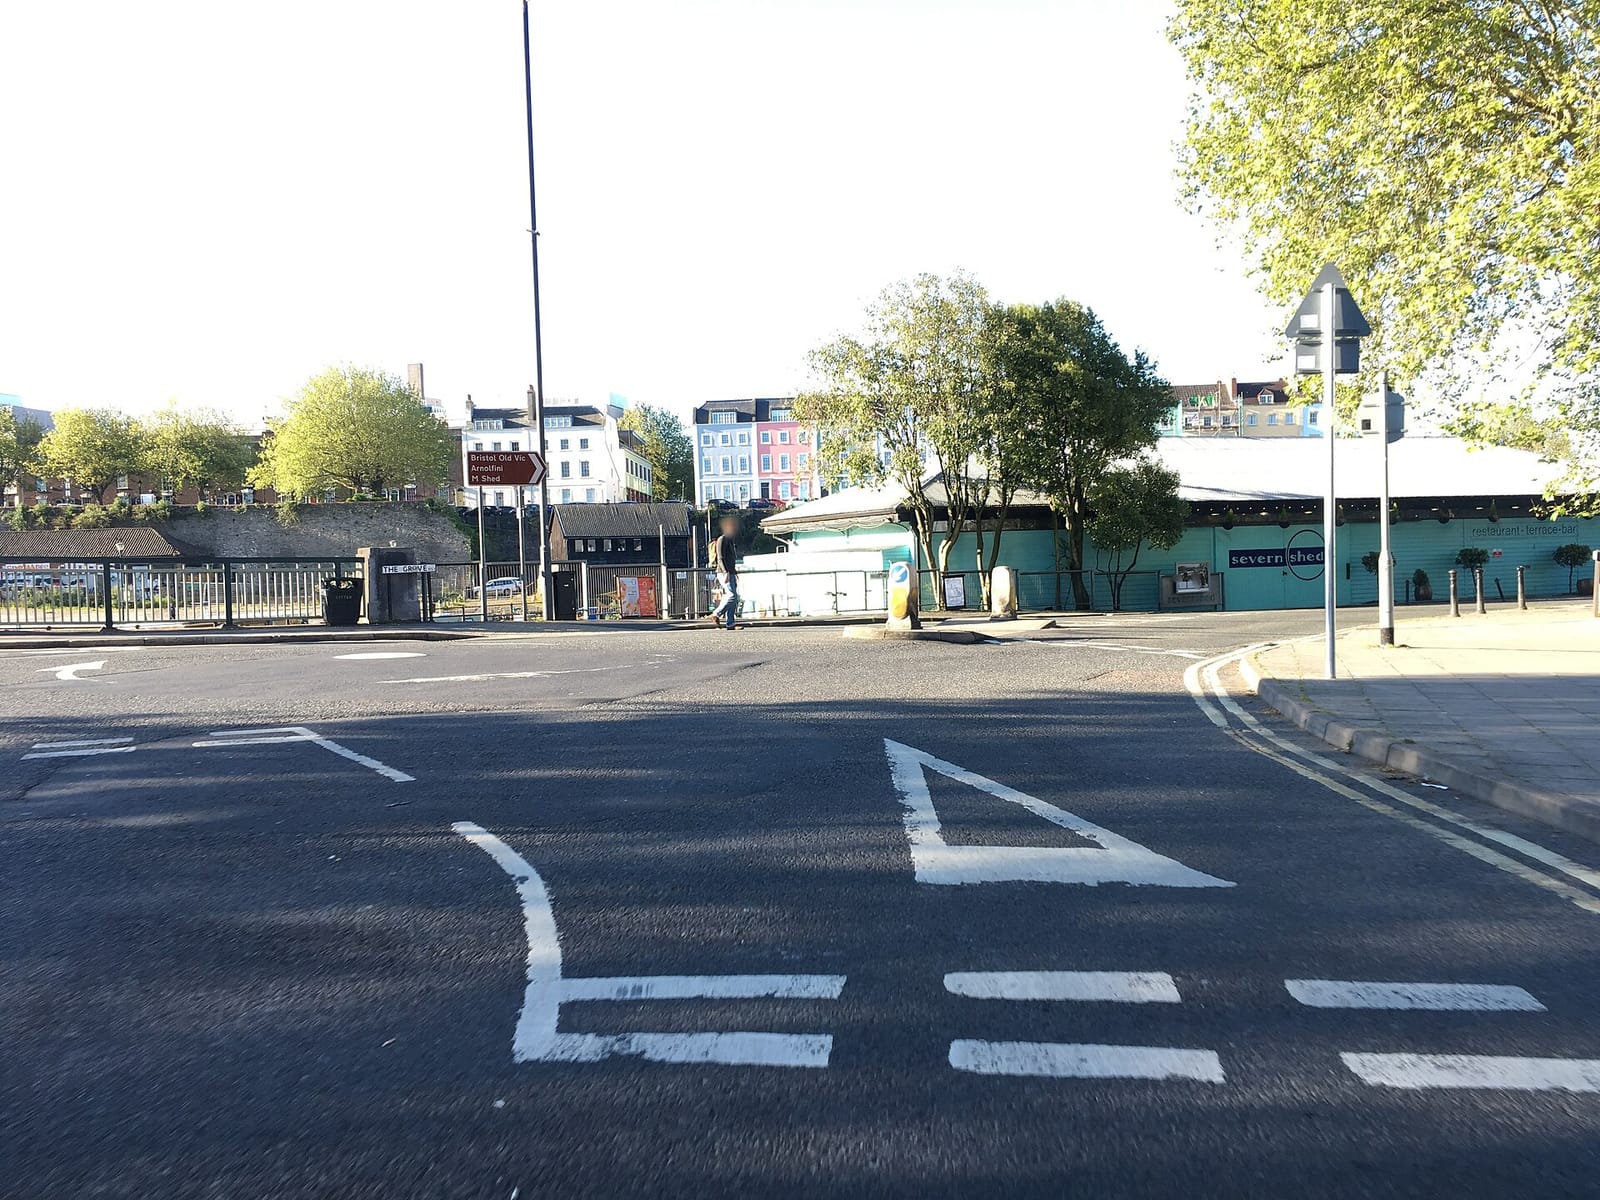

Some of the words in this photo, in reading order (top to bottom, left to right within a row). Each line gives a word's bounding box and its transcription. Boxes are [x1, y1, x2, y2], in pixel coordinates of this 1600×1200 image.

[471, 454, 496, 462] Bristol
[498, 454, 512, 462] Old
[514, 454, 526, 462] Vic
[1472, 525, 1520, 536] restaurant
[1526, 525, 1558, 535] terrace
[1561, 524, 1577, 534] bar
[1231, 555, 1283, 565] severn
[1290, 550, 1324, 562] shed
